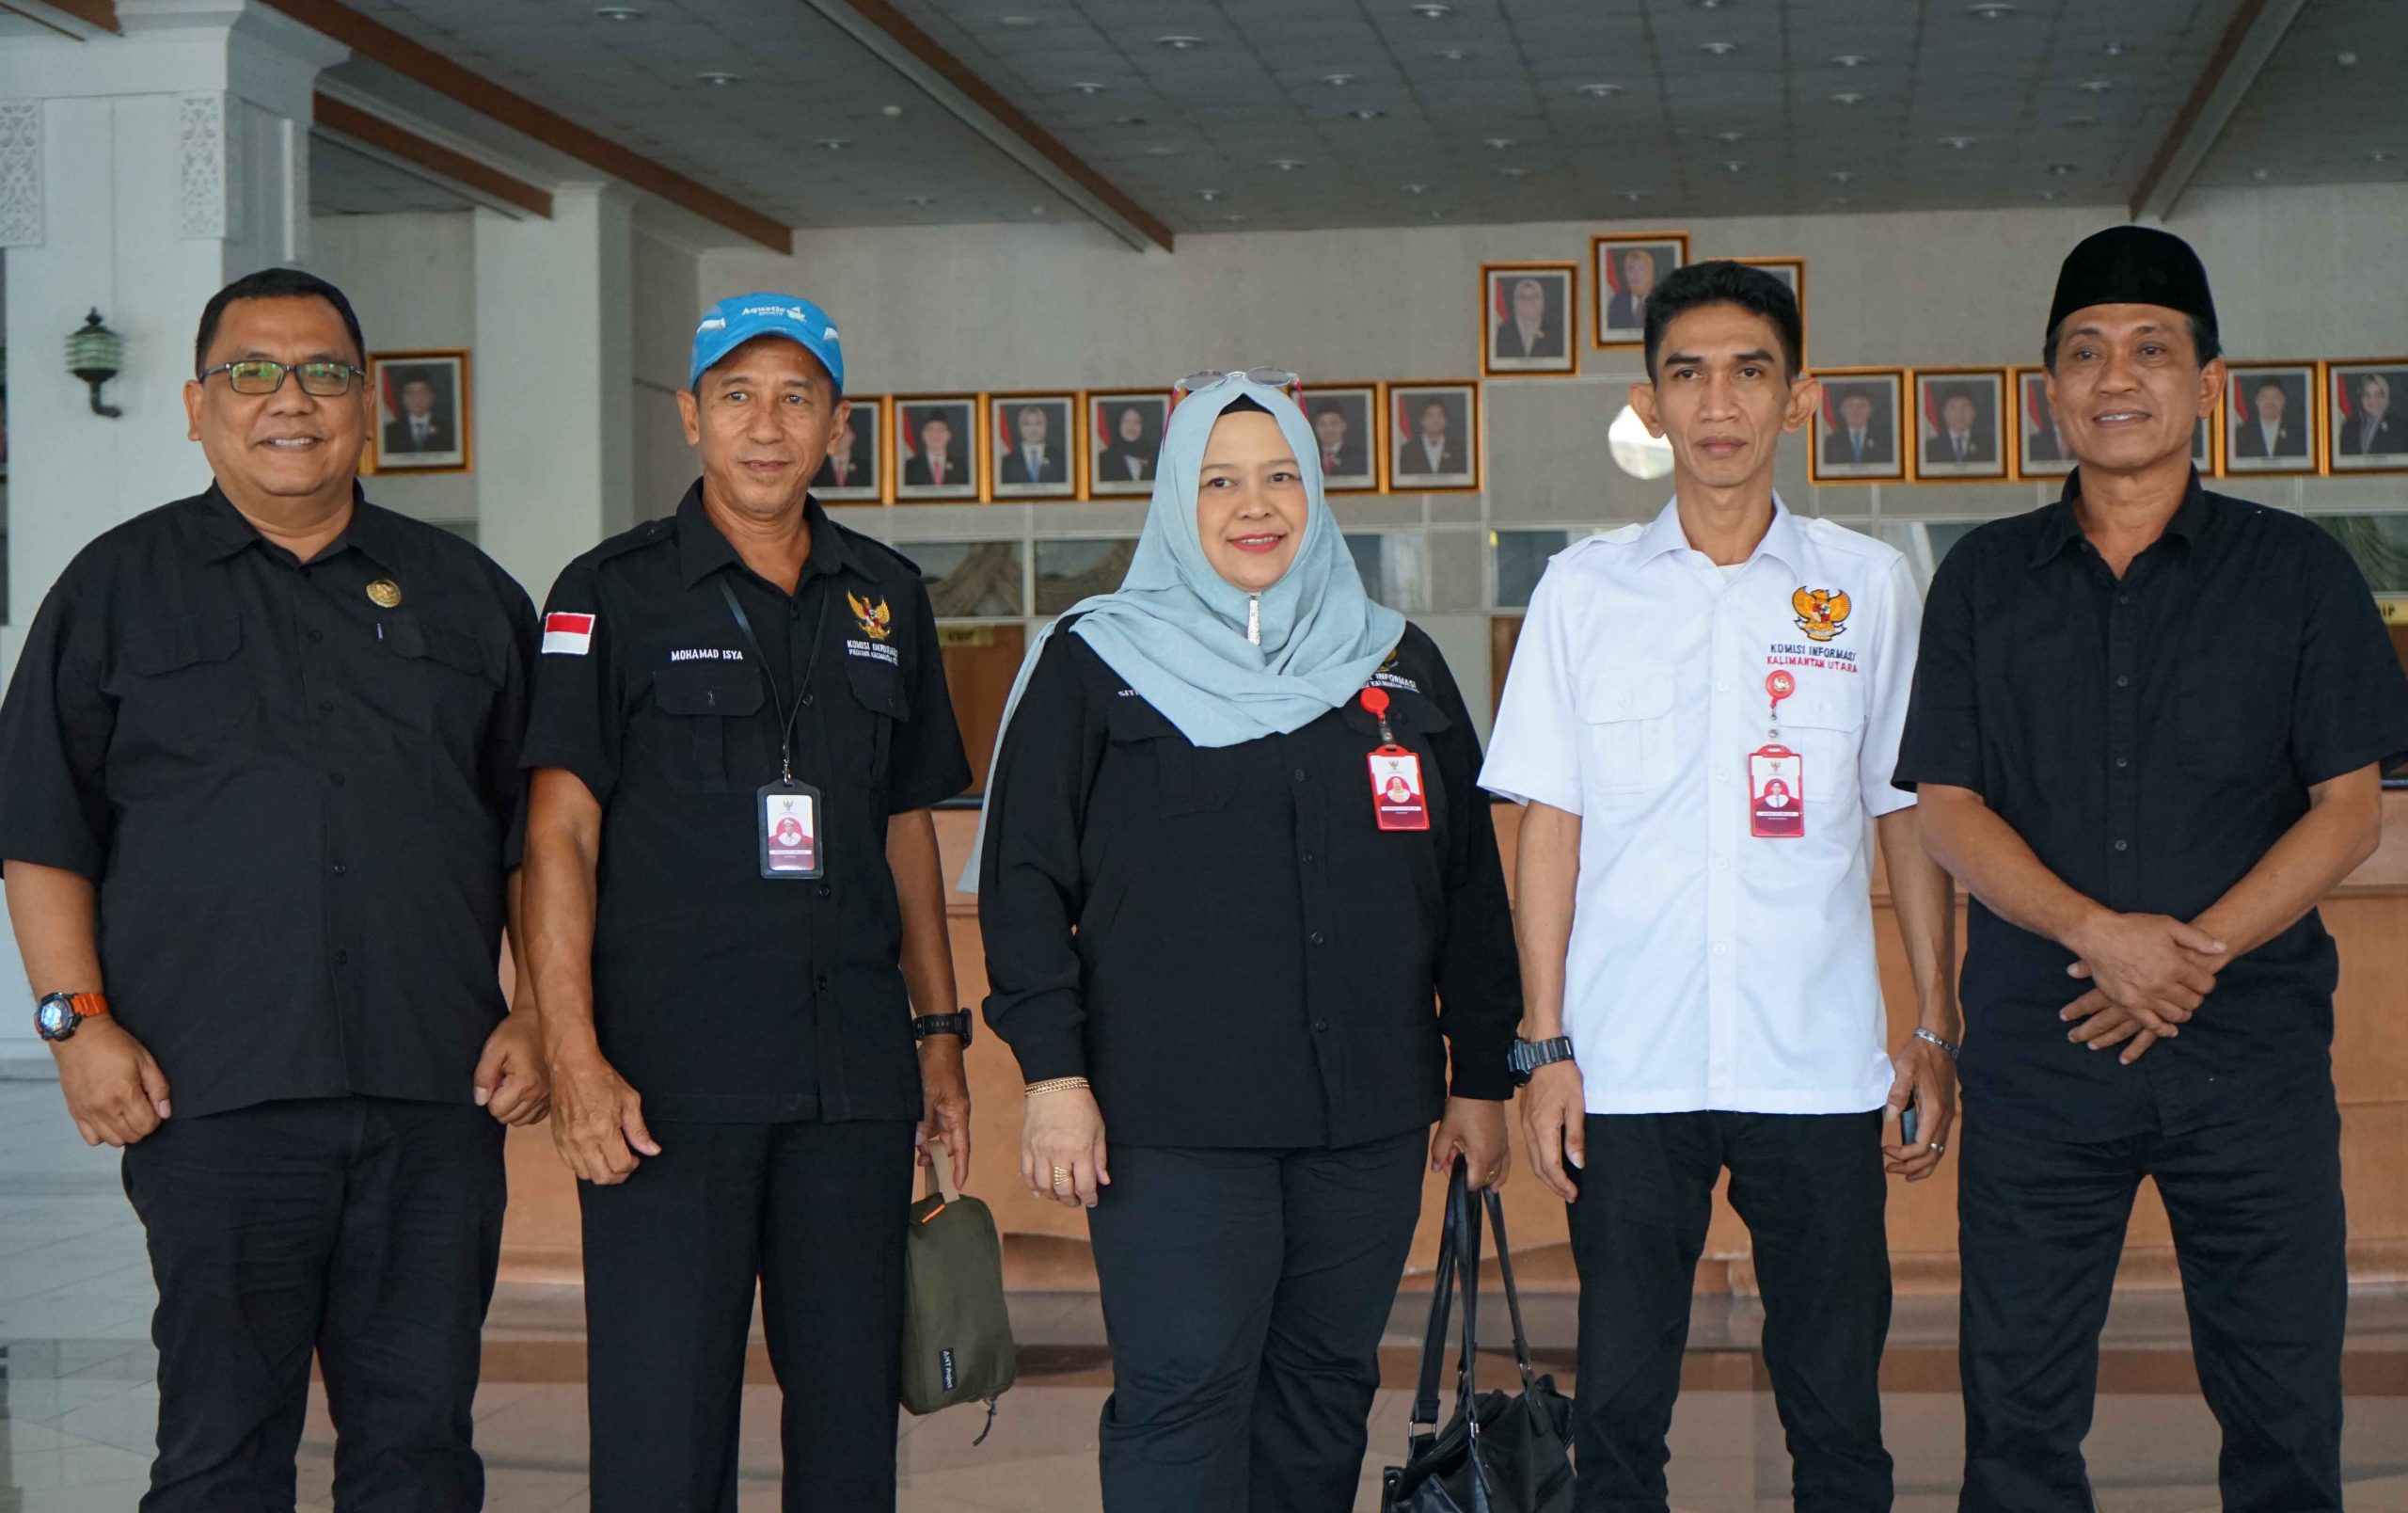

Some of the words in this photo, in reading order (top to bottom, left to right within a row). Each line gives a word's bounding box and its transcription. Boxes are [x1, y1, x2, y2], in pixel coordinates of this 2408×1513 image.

[742, 306, 786, 316] Aquatic
[671, 648, 720, 661] MOHAMAD
[722, 649, 743, 661] ISYA
[872, 643, 898, 659] INFORMAS
[1770, 643, 1806, 655] KOMISI
[1809, 645, 1857, 661] INFORMASI
[1766, 655, 1825, 668] KALIMANTAN
[1828, 661, 1859, 674] UTARA
[1375, 673, 1417, 689] INFORMASI
